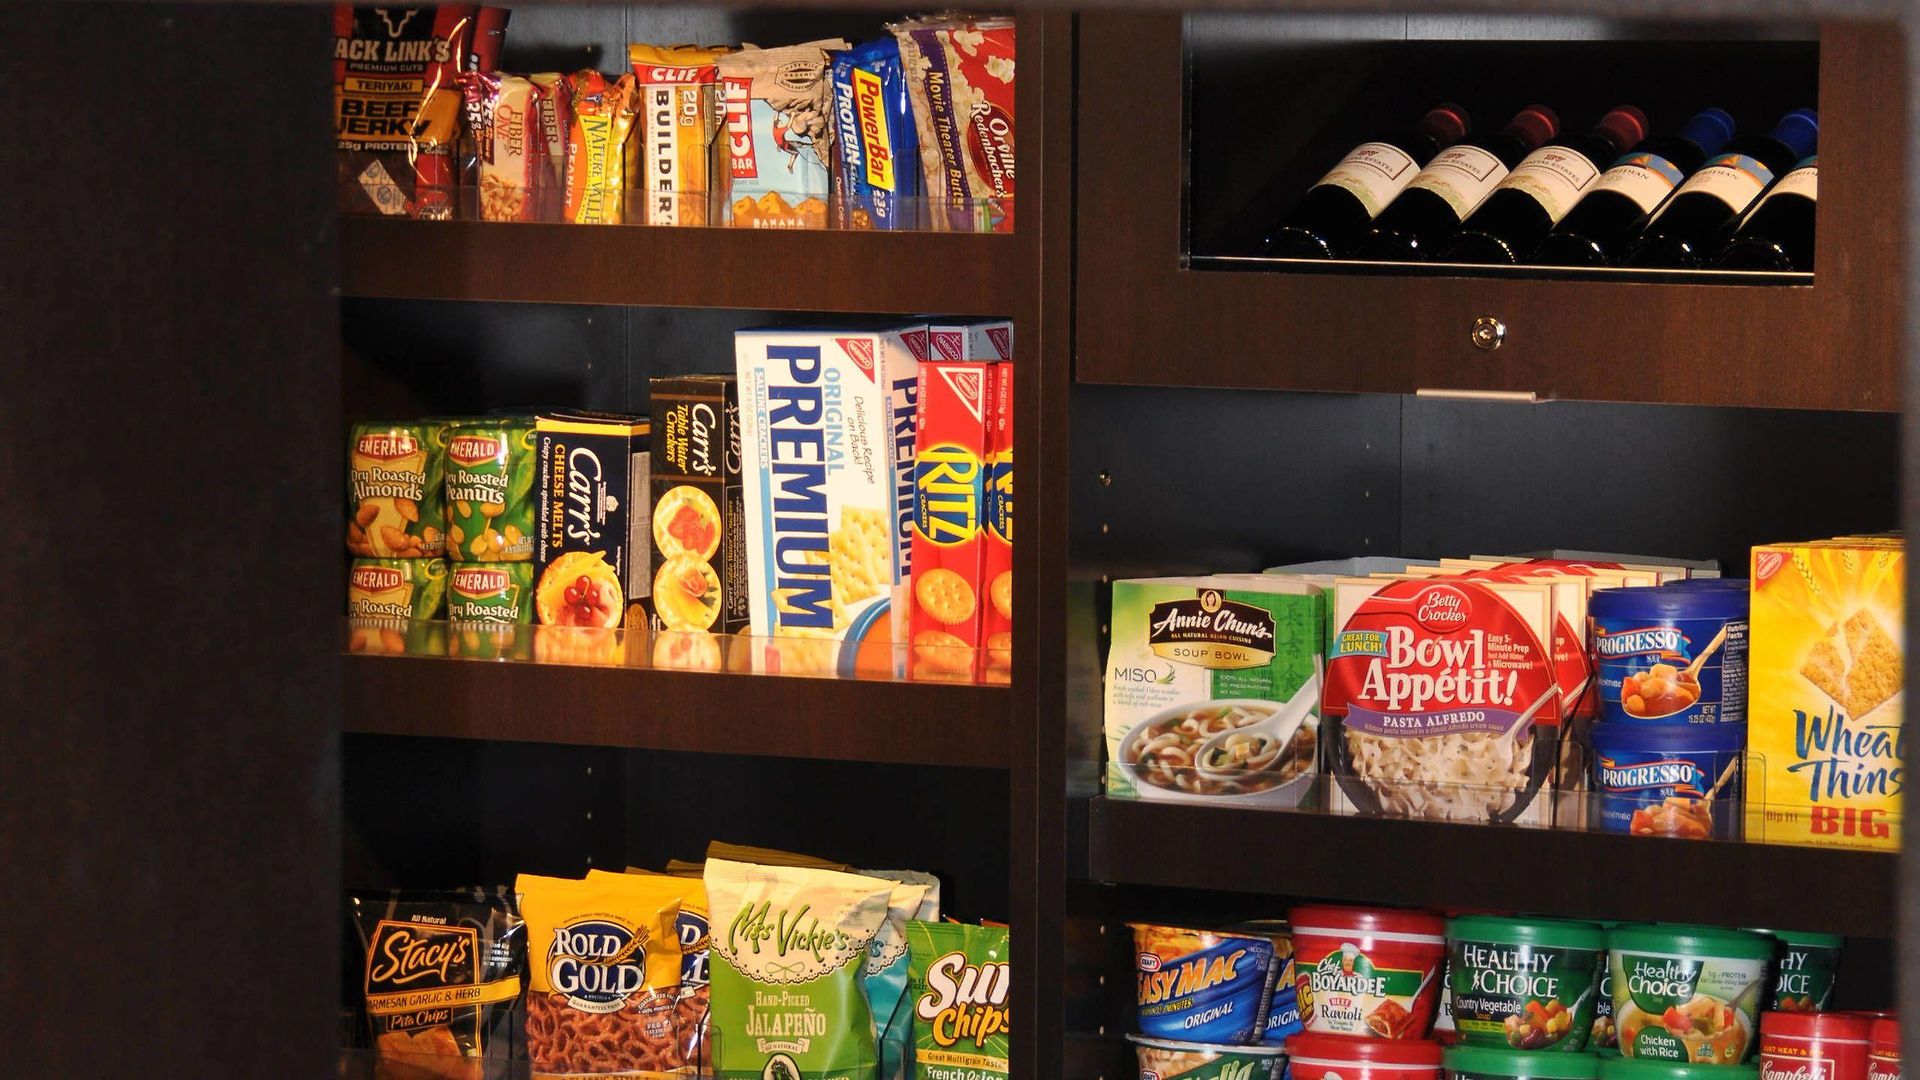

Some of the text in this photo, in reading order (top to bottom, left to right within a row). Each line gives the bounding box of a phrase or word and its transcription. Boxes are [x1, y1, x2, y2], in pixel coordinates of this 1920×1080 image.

[336, 39, 450, 62] ACK LINK'S
[350, 63, 397, 71] PREMIUM
[652, 68, 699, 82] CLIF
[357, 81, 413, 90] TERIYAKI
[341, 100, 420, 117] BEEF
[680, 90, 698, 127] 20g
[726, 81, 751, 157] CLIF
[497, 104, 513, 140] ONE
[509, 110, 523, 157] FIBER
[542, 99, 558, 144] FIBER
[836, 82, 861, 168] PROTEIN
[859, 77, 890, 183] PowerBar
[339, 142, 361, 150] 25g
[364, 143, 416, 151] PROTEIN
[928, 71, 965, 211] Movie Theater Butter
[970, 100, 1007, 199] Redenbacher's
[989, 117, 1016, 179] Orville
[656, 90, 673, 224] BUILDER'
[731, 158, 754, 171] BAR
[564, 143, 578, 208] PEANUT
[583, 118, 608, 224] NATURE VALLE
[872, 190, 887, 218] 23g
[753, 218, 805, 230] BANANA
[823, 367, 845, 475] ORIGINAL
[542, 436, 551, 461] Crispy
[666, 411, 678, 463] Crackers
[677, 404, 689, 475] Table Water
[692, 403, 717, 477] Carr's
[853, 396, 875, 485] Delicious Recipe
[850, 434, 863, 466] Back!
[371, 466, 427, 485] Roasted
[457, 470, 509, 489] Roasted
[541, 461, 550, 489] crackers
[767, 344, 835, 630] PREMIUM
[540, 490, 549, 523] sprinkled
[552, 443, 566, 549] CHEESE MELTS
[567, 446, 602, 547] Carr's
[917, 450, 978, 540] RITZ
[540, 523, 549, 541] with
[352, 570, 399, 588] EMERALD
[454, 572, 506, 590] EMERALD
[361, 598, 413, 618] Roasted
[466, 600, 519, 620] Roasted
[1427, 592, 1462, 611] Betty
[1151, 608, 1273, 639] Annie Chun's
[1418, 605, 1468, 624] Crocker
[1183, 632, 1208, 640] NATURAL
[1340, 642, 1383, 653] LUNCH!
[1341, 633, 1380, 643] GREAT FOR
[1386, 626, 1487, 670] Bowl
[1487, 633, 1504, 645] Easy
[1487, 642, 1530, 655] Minute Prep
[1596, 630, 1680, 654] PROGRESSO
[1173, 648, 1250, 662] SOUP BOWL
[1492, 659, 1534, 670] Microwave!
[1114, 667, 1157, 684] MISO
[1358, 658, 1519, 712] Appétit!
[1383, 711, 1486, 728] PASTA ALFREDO
[1603, 763, 1693, 787] PROGRESSO
[1787, 757, 1905, 802] Thins
[1810, 806, 1890, 838] BIG
[422, 915, 447, 924] Natural
[729, 900, 775, 956] Miss
[775, 903, 850, 964] Vickie's
[552, 926, 623, 960] ROLD
[371, 930, 470, 985] Stacy's
[1141, 958, 1156, 966] KRAFT
[1317, 957, 1342, 975] Chef
[1464, 944, 1555, 974] HEALTHY
[552, 957, 645, 995] GOLD
[1175, 950, 1246, 997] MAC
[1634, 958, 1698, 984] Healthy
[1312, 971, 1387, 998] BOYARDEE
[1480, 969, 1559, 999] CHOICE
[1629, 975, 1691, 998] Choice
[367, 996, 407, 1010] ARMESAN
[409, 994, 443, 1005] GARLIC
[455, 987, 482, 1001] HERB
[755, 990, 810, 1008] HAND-PICKED
[1456, 996, 1522, 1015] Country Vegetable
[390, 1008, 449, 1029] Pita Chips
[745, 1004, 827, 1037] JALAPEÑO
[933, 1001, 1009, 1048] Chips
[1184, 1002, 1233, 1030] ORIGINAL
[1266, 1010, 1300, 1031] RIGIN
[1321, 1004, 1363, 1022] Ravioli
[1640, 1034, 1676, 1048] Chicken
[1640, 1046, 1680, 1059] with Rice
[1778, 1047, 1798, 1055] HEAT
[927, 1053, 945, 1061] Great
[946, 1054, 981, 1066] Multigrain
[927, 1066, 965, 1080] French
